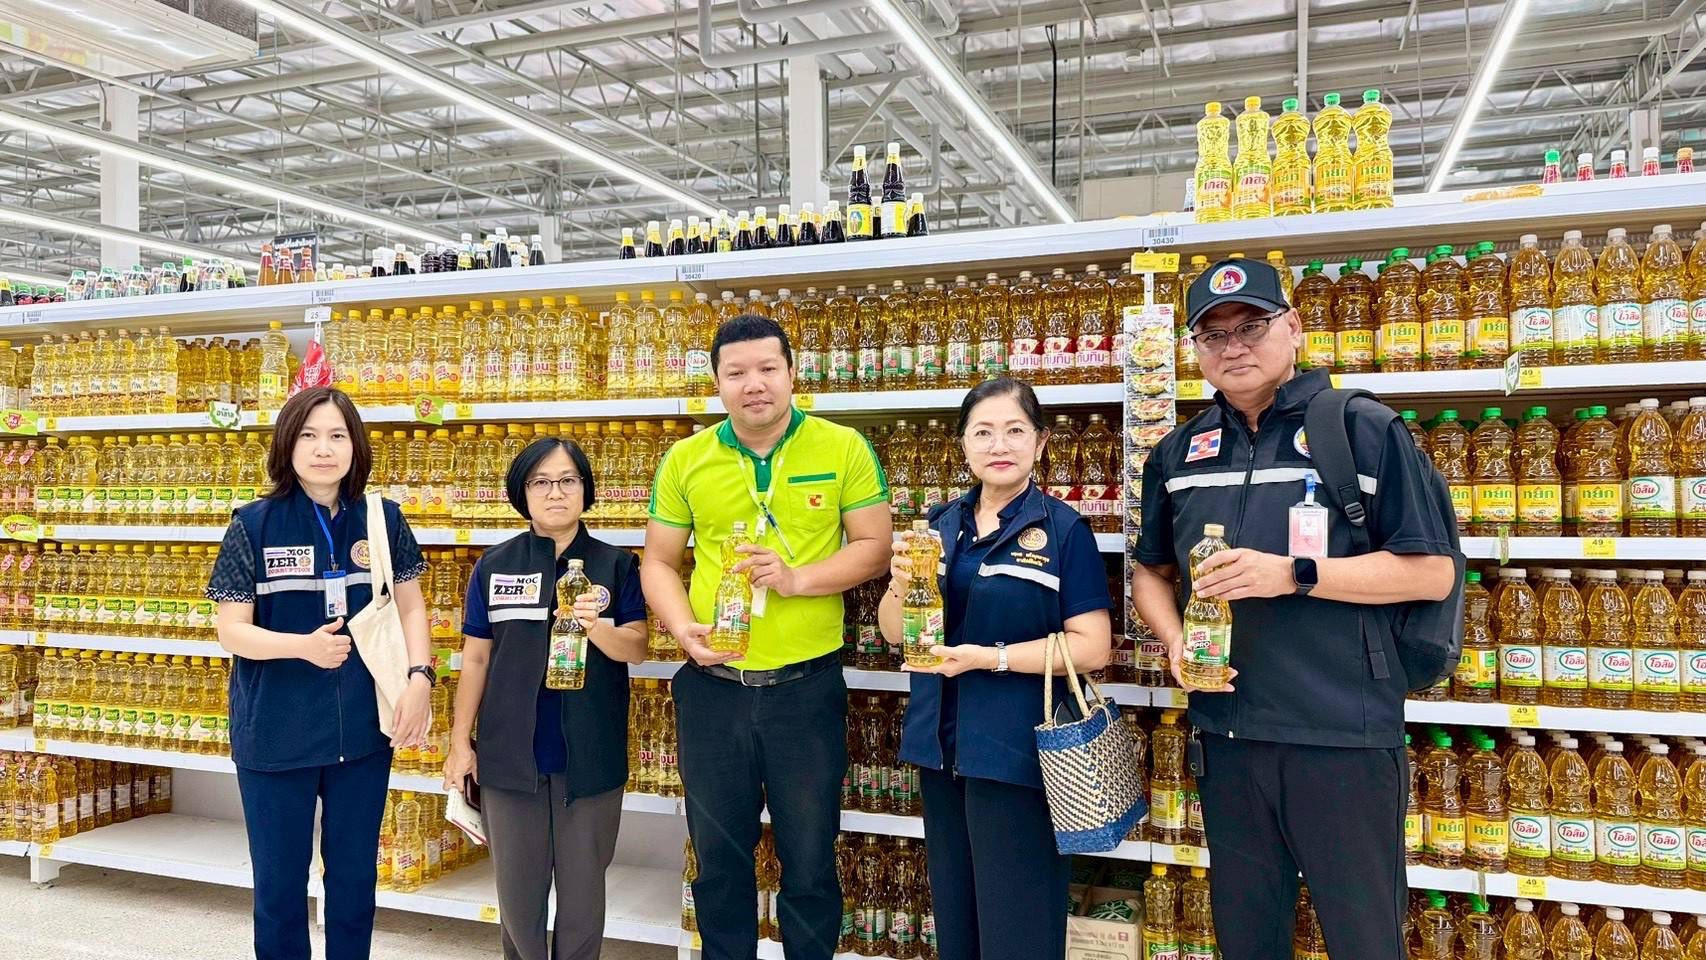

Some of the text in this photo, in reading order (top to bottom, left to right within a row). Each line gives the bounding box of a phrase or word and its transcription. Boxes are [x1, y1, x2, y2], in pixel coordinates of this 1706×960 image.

[1204, 179, 1228, 191] เกสร
[1152, 237, 1174, 245] 30430
[1161, 257, 1175, 266] 15
[310, 311, 319, 319] 25
[1482, 489, 1512, 499] หยก
[1523, 488, 1553, 499] หยก
[1582, 488, 1614, 499] หยก
[1632, 483, 1656, 494] โอลีน
[1081, 499, 1109, 512] ทับทิม
[286, 548, 311, 556] MOC
[267, 567, 311, 575] CORRUPTION
[1510, 653, 1532, 663] โอลีน
[1565, 655, 1585, 665] โอลีน
[1608, 656, 1630, 667] โอลีน
[1650, 657, 1675, 668] โอลีน
[1473, 824, 1504, 836] หยก
[1515, 821, 1539, 833] โอลีน
[1562, 826, 1586, 838] โอลีน
[1612, 831, 1636, 842] โอลีน
[1651, 833, 1677, 845] โอลีน
[1525, 878, 1537, 886] 49
